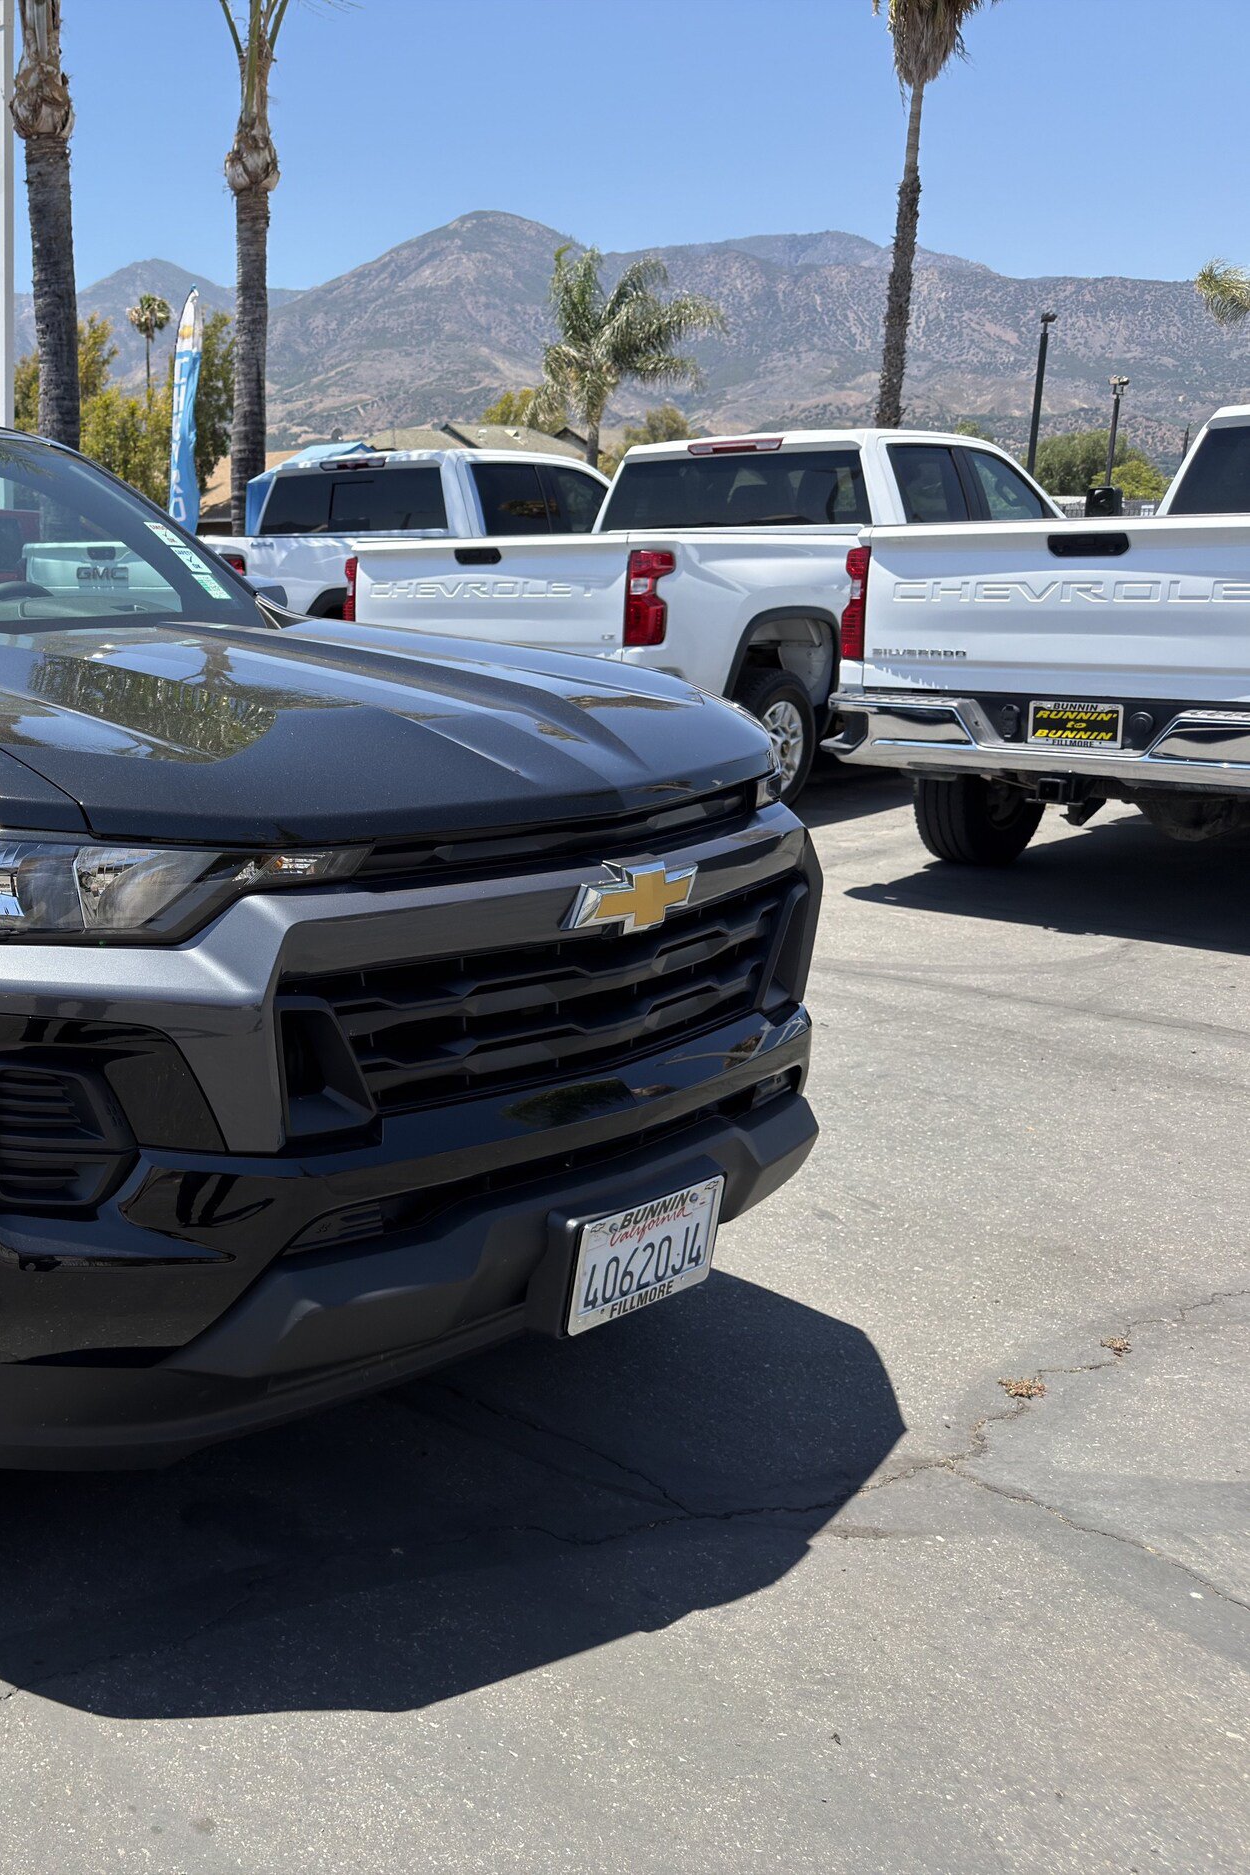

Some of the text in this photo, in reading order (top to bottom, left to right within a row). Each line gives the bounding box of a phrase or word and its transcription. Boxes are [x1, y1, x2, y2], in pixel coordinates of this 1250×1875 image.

[76, 566, 129, 580] GMC
[369, 582, 596, 598] CHEVROLET
[872, 648, 967, 657] SILVERADO
[1053, 702, 1099, 711] BUNNIN
[1035, 710, 1118, 721] RUNNIN'
[1066, 721, 1087, 729] to
[1034, 729, 1113, 740] BUNNIN
[1053, 740, 1095, 748] FILLMORE
[619, 1190, 691, 1230] BUNNIN
[609, 1205, 693, 1247] California
[583, 1222, 702, 1309] 40620J4
[609, 1279, 675, 1318] FILLMORE
